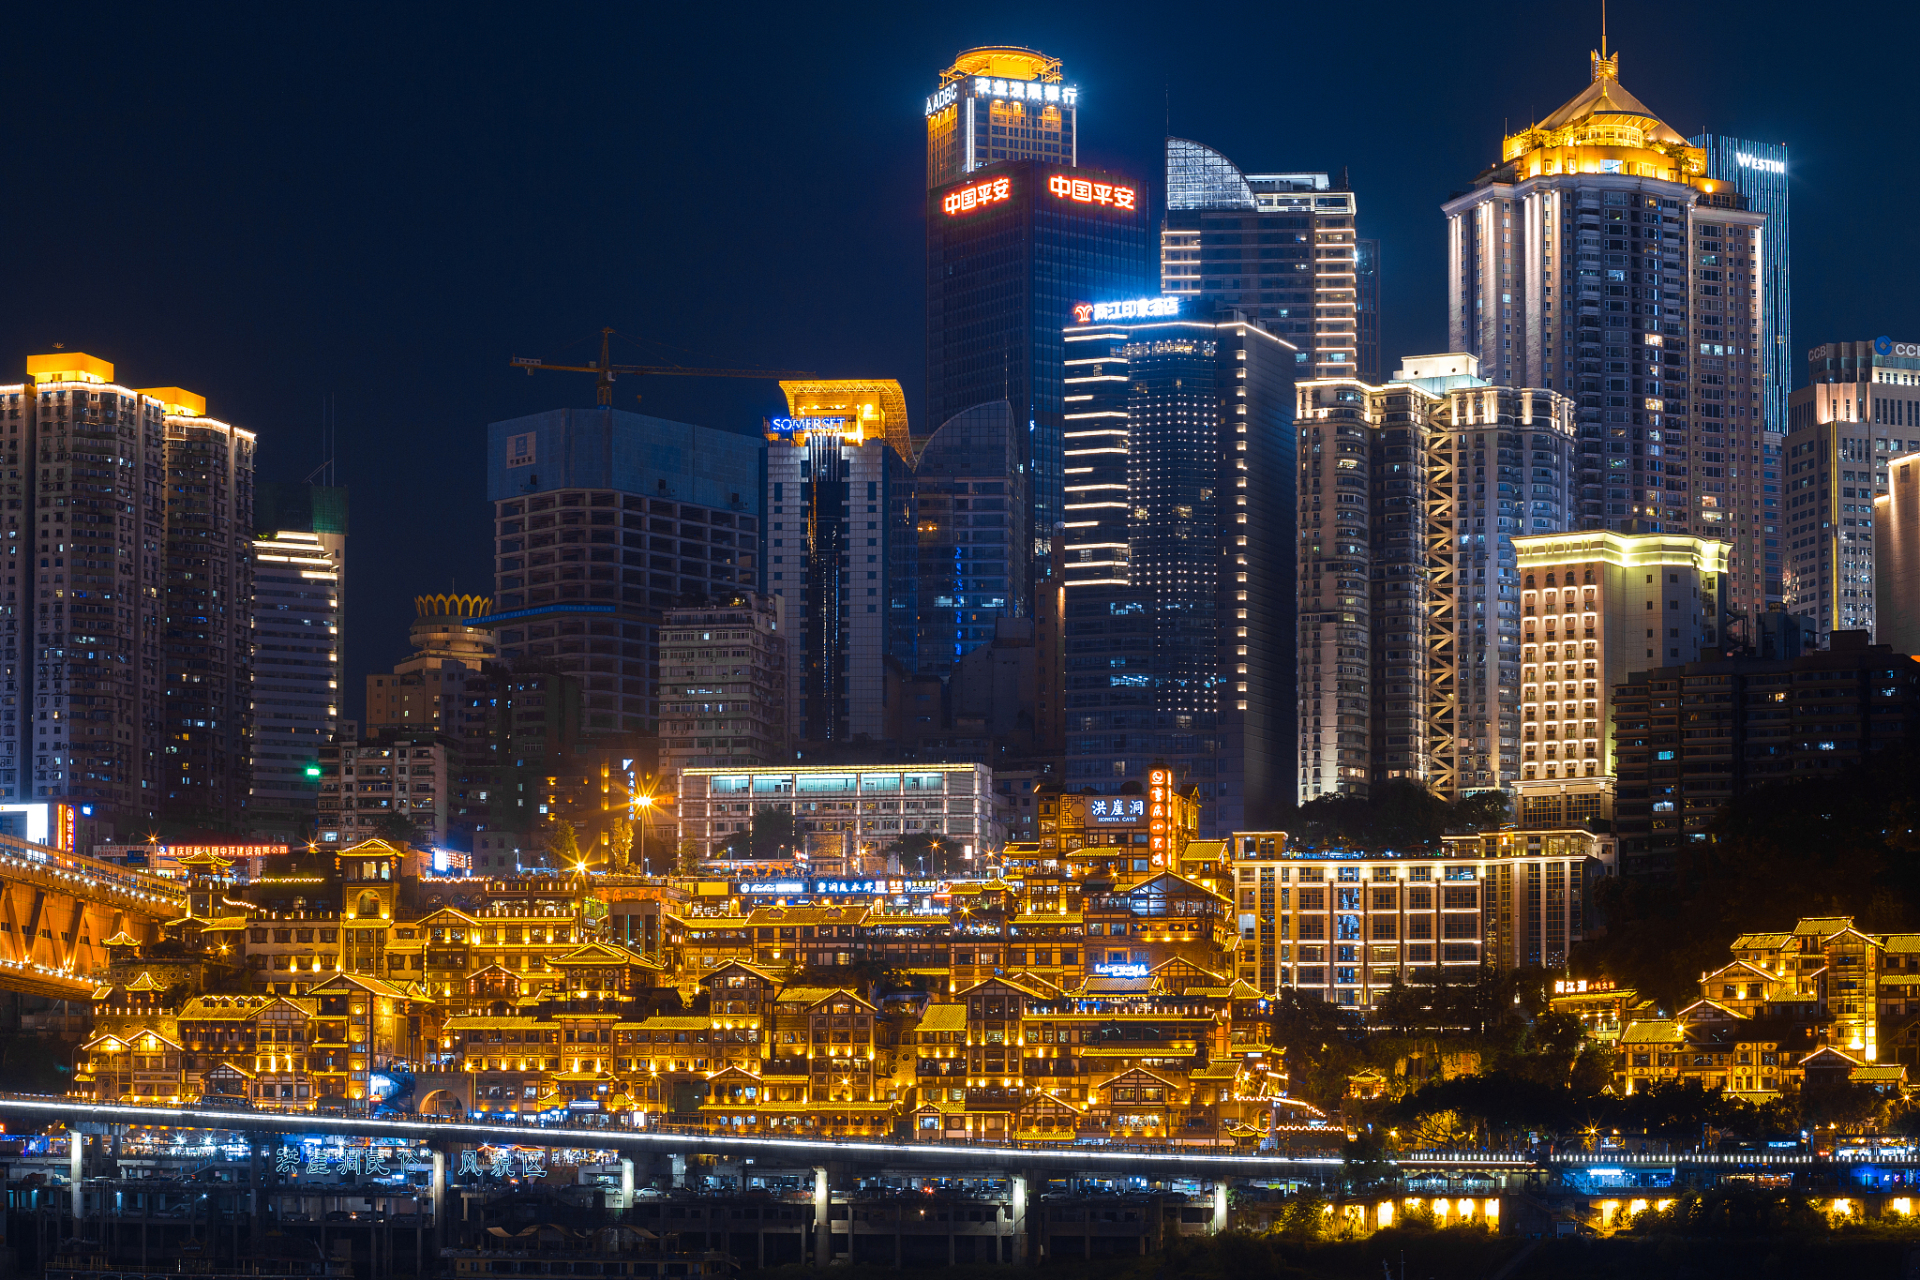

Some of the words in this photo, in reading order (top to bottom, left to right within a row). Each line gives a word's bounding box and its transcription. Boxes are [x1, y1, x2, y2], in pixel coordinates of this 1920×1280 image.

[1736, 152, 1785, 173] WESTIN
[945, 178, 1009, 214] 中国平安
[1049, 175, 1134, 209] 中国平安
[1808, 346, 1826, 361] CCB
[1895, 344, 1920, 357] CC
[773, 418, 845, 430] SOMERSET
[1091, 799, 1144, 816] 洪崖洞
[275, 1149, 548, 1177] 洪崖洞民俗风貌区
